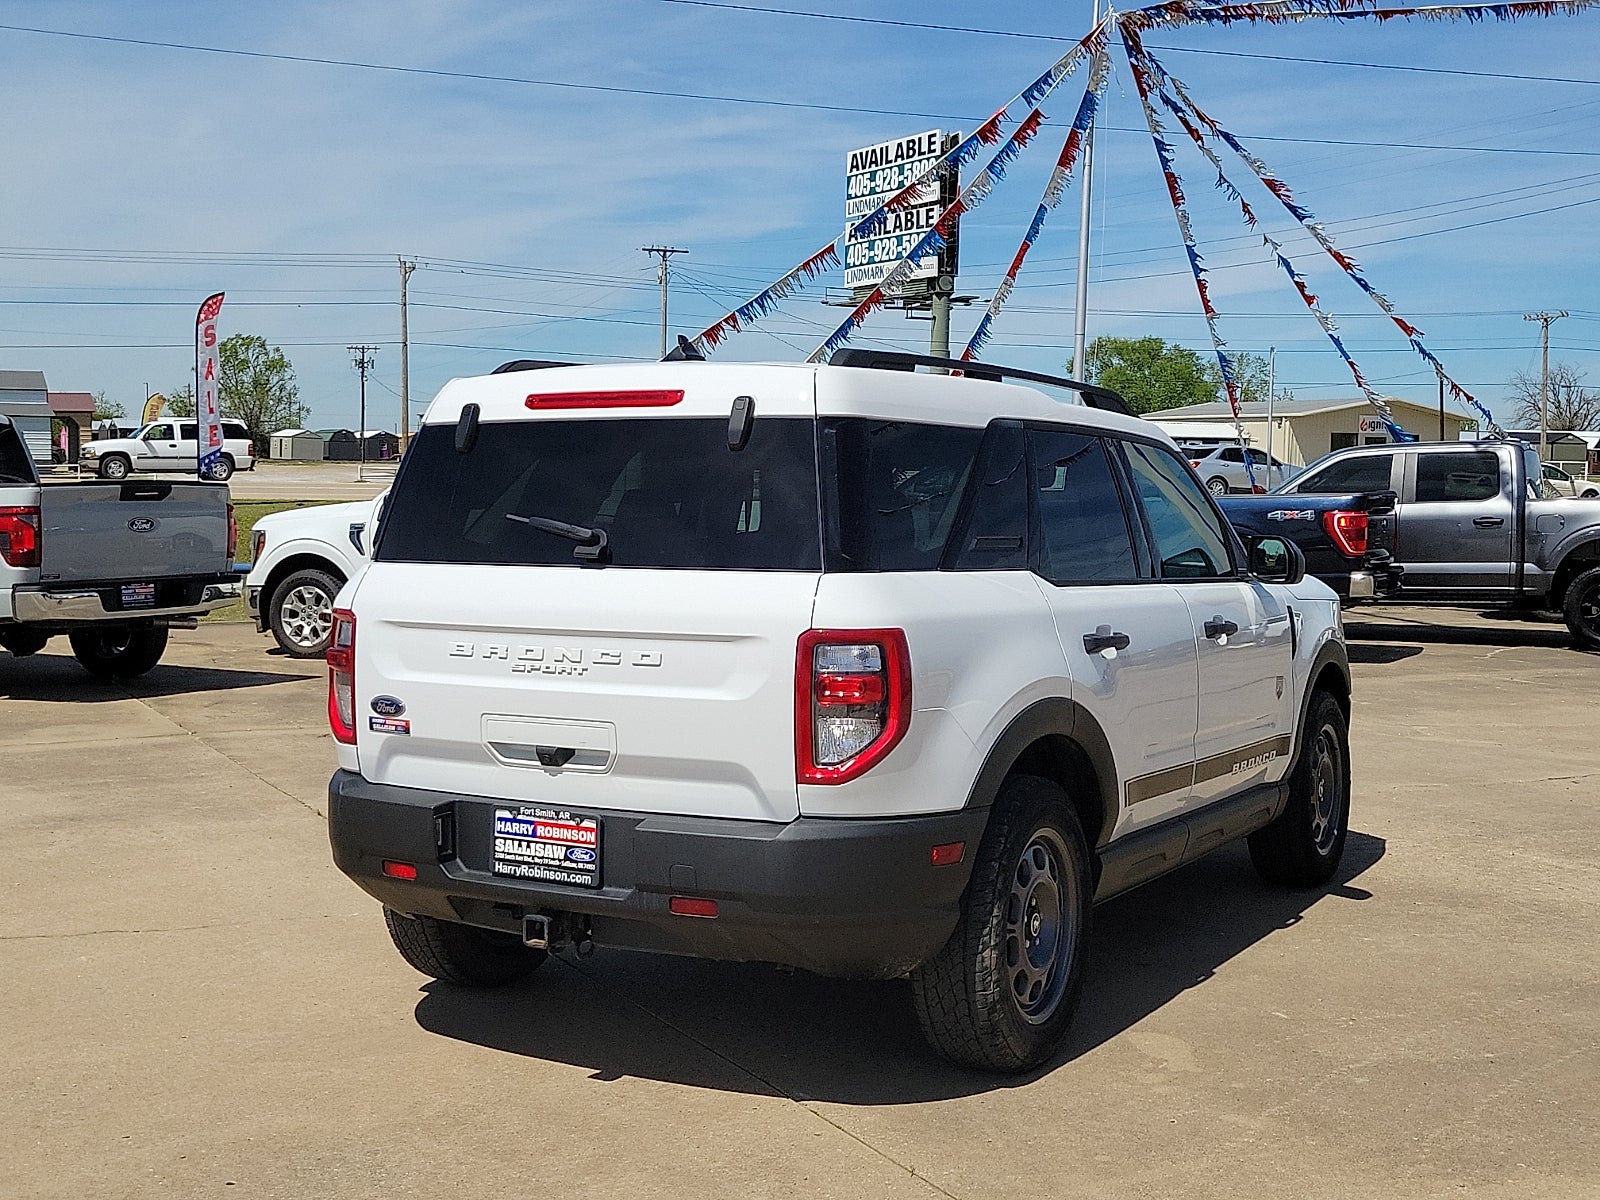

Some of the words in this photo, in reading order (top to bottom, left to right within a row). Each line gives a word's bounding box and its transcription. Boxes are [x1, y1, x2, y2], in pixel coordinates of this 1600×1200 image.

[849, 132, 937, 173] AVAILABLE
[847, 207, 935, 243] AILABLE
[846, 232, 927, 267] 405-928-58
[204, 324, 221, 447] SALE
[132, 519, 152, 530] Ford
[448, 641, 663, 668] BRONCO
[511, 663, 588, 676] SPORT
[1232, 750, 1277, 776] BRONCO
[520, 806, 534, 816] Fort
[535, 808, 557, 820] Smith,
[559, 811, 571, 820] AR
[496, 820, 535, 836] HARRY
[536, 825, 596, 843] ROBINSON
[494, 838, 567, 860] SALLISAW
[571, 848, 591, 861] Ford
[494, 861, 592, 885] HarryRobinson.com
